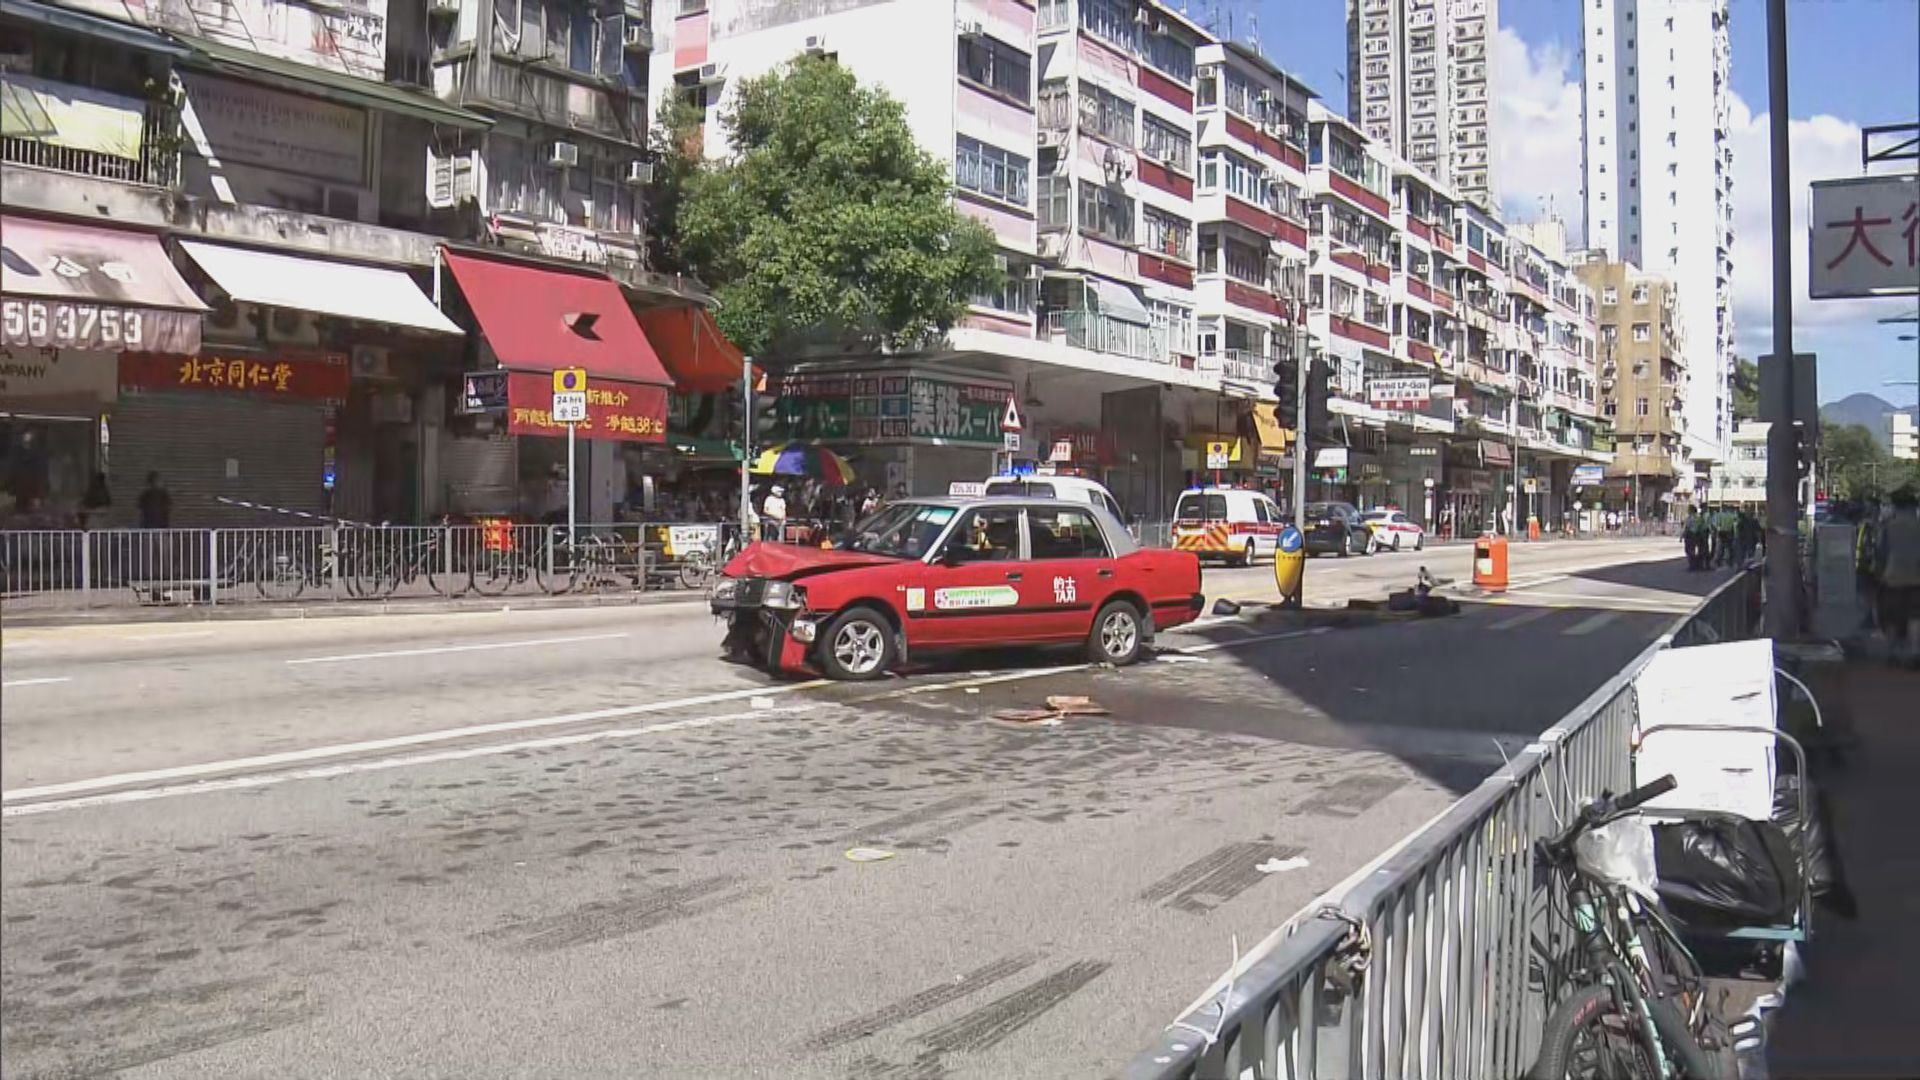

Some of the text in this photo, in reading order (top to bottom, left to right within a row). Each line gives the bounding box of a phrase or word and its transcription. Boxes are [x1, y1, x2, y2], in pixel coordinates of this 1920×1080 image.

[56, 303, 142, 344] 3753
[180, 357, 292, 391] 北京同仁堂
[556, 396, 568, 405] 24
[1053, 575, 1076, 590] 的士
[1053, 588, 1077, 604] TAXI
